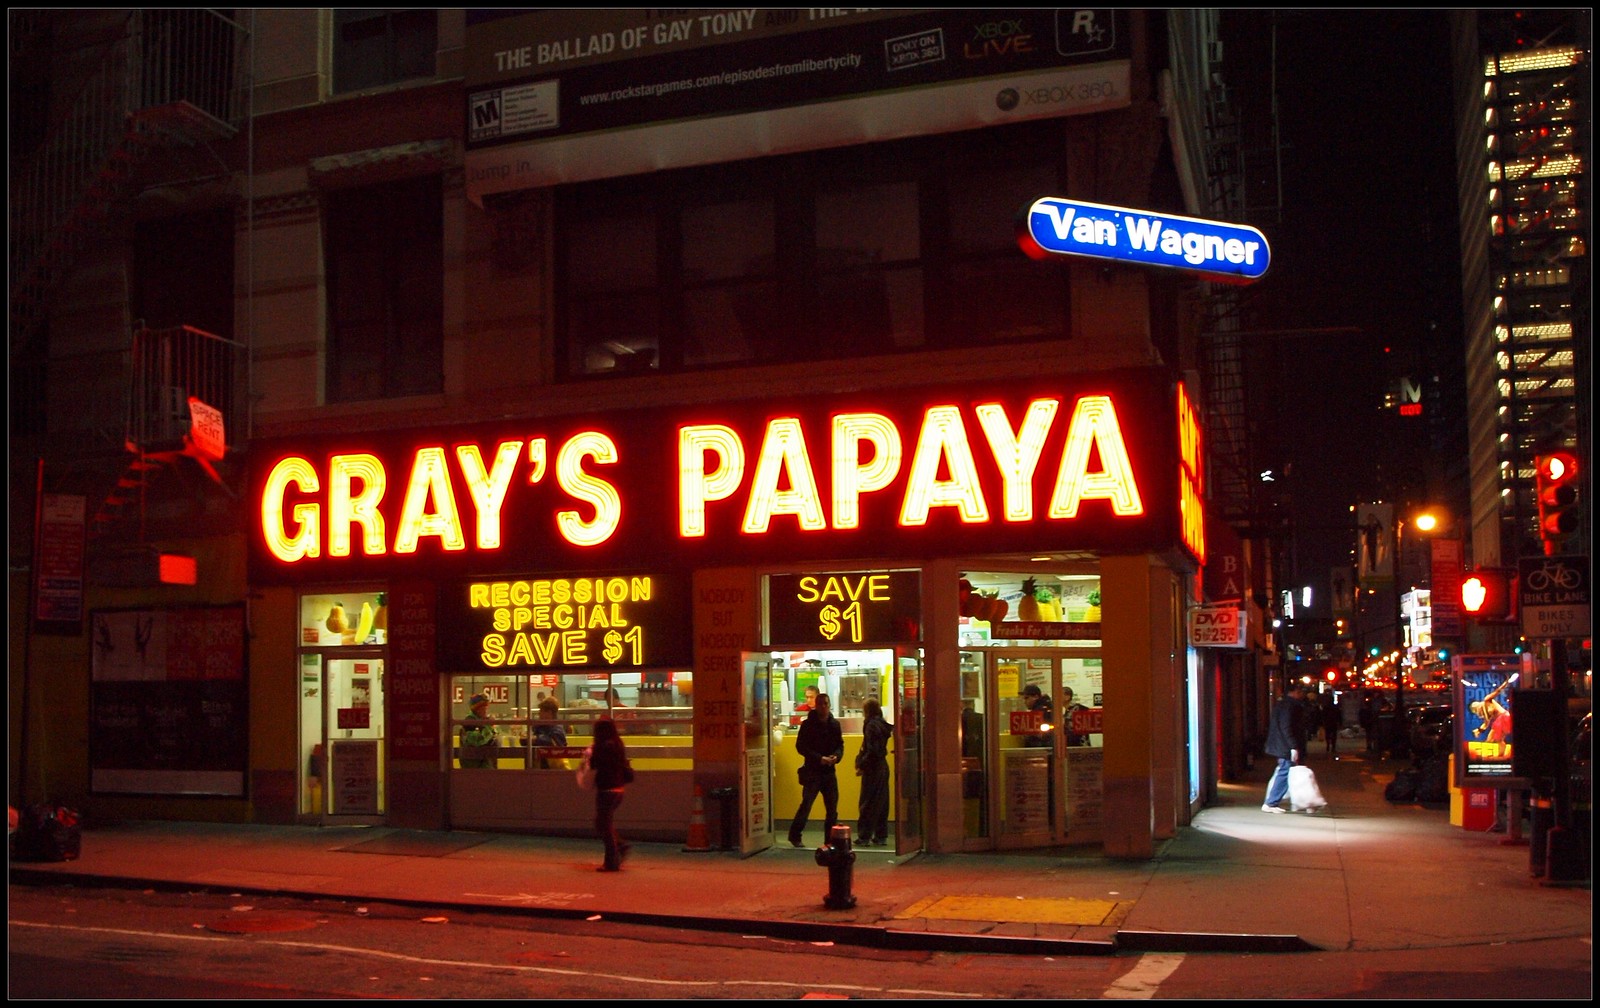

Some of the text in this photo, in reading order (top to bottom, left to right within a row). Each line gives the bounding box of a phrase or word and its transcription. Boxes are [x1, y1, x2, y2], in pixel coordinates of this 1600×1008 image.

[974, 19, 1023, 38] XBOX
[494, 49, 532, 72] THE
[537, 32, 616, 65] BALLAD
[621, 26, 648, 50] OF
[653, 19, 694, 44] GAY
[699, 9, 758, 37] TONY
[963, 35, 1035, 58] LIVE
[580, 52, 862, 106] www.rockstargames.com/episodesfromlibertycity
[1024, 85, 1076, 105] XBOX
[473, 99, 500, 128] M
[1046, 206, 1259, 265] Van Wagner
[261, 431, 622, 563] GRAY'S
[679, 395, 1145, 537] PAPAYA
[469, 577, 652, 608] RECESSION
[700, 588, 745, 603] NOBODY
[797, 575, 891, 602] SAVE
[1523, 591, 1589, 604] BIKE LANE
[493, 602, 628, 632] SPECIAL
[712, 611, 734, 627] BUT
[819, 601, 863, 643] $1
[1196, 613, 1232, 625] DVD
[1538, 610, 1574, 621] BIKES
[1541, 622, 1573, 633] ONLY
[481, 626, 642, 667] SAVE $1
[700, 633, 746, 648] NOBODY
[720, 677, 728, 693] A
[483, 687, 508, 703] SALE
[703, 701, 740, 716] BETTE
[1012, 714, 1041, 732] SALE
[1075, 712, 1102, 730] SALE
[725, 723, 740, 738] DO
